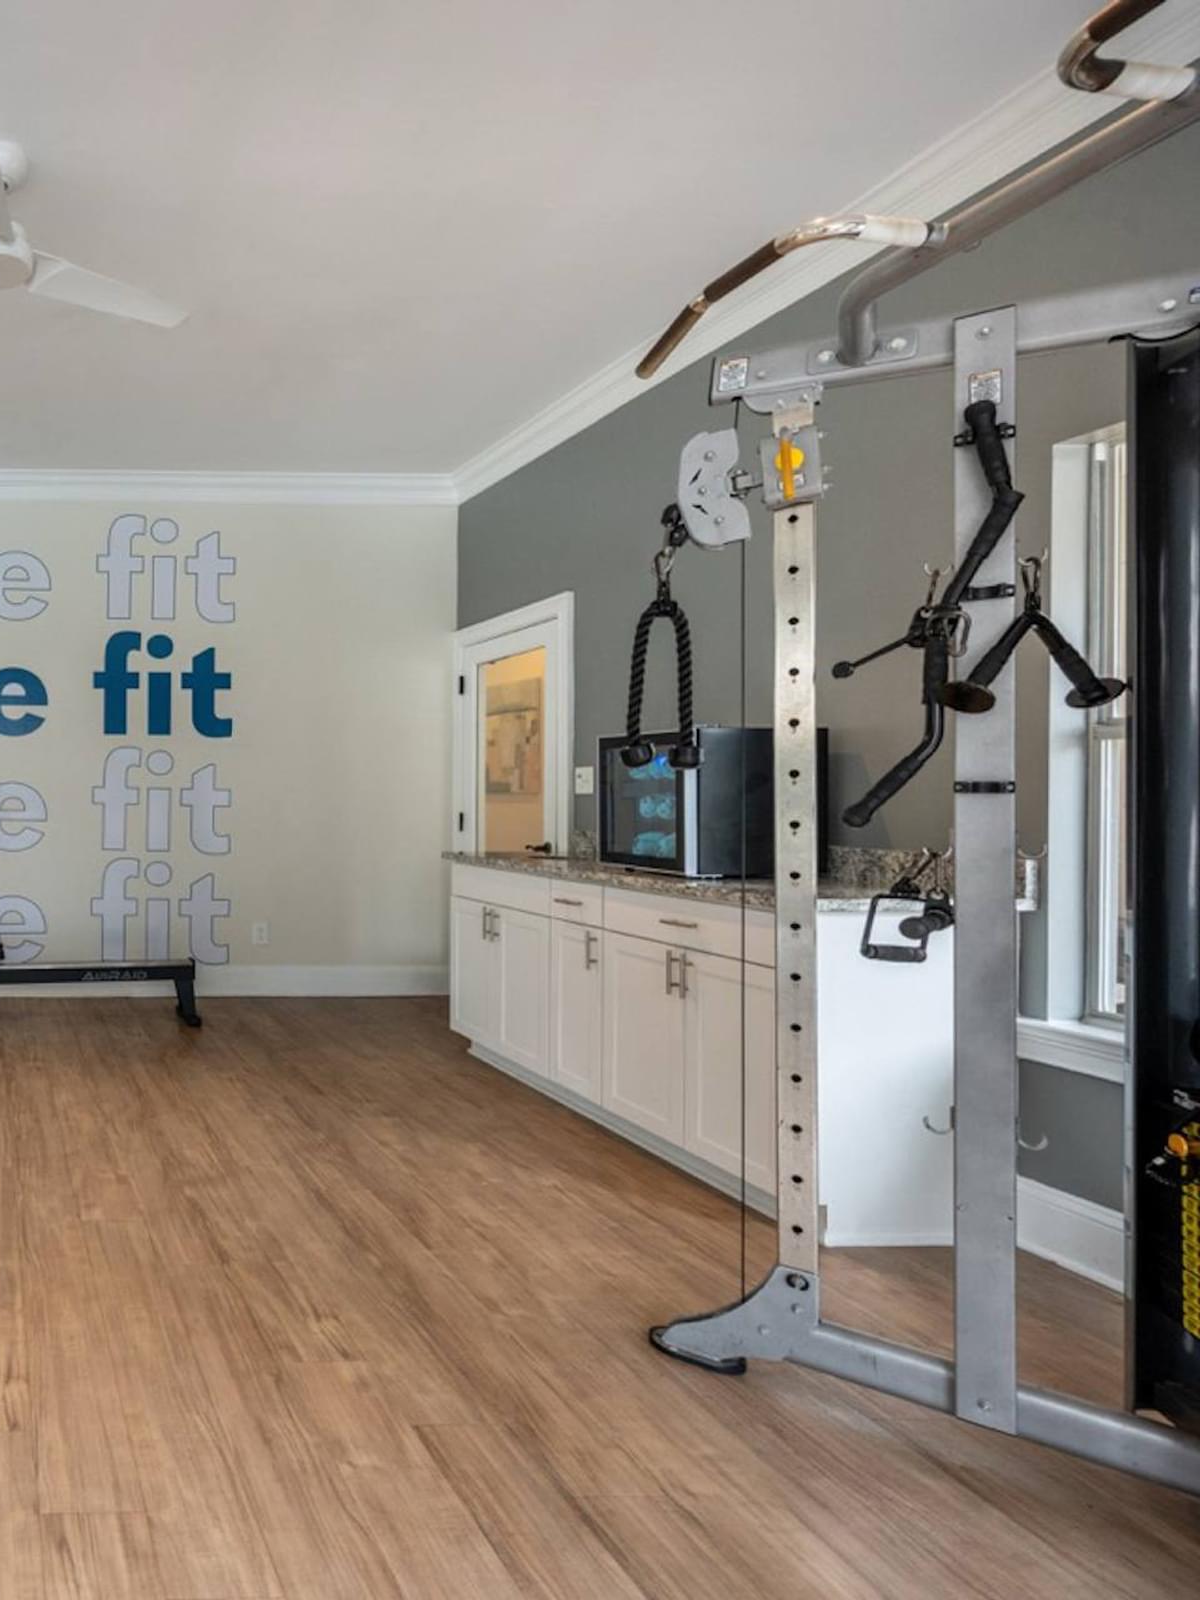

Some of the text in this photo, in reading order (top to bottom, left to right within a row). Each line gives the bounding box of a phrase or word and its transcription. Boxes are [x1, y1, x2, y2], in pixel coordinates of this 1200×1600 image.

[96, 514, 237, 624] fit
[93, 630, 233, 738] fit
[92, 746, 232, 855] fit
[91, 857, 231, 965] fit
